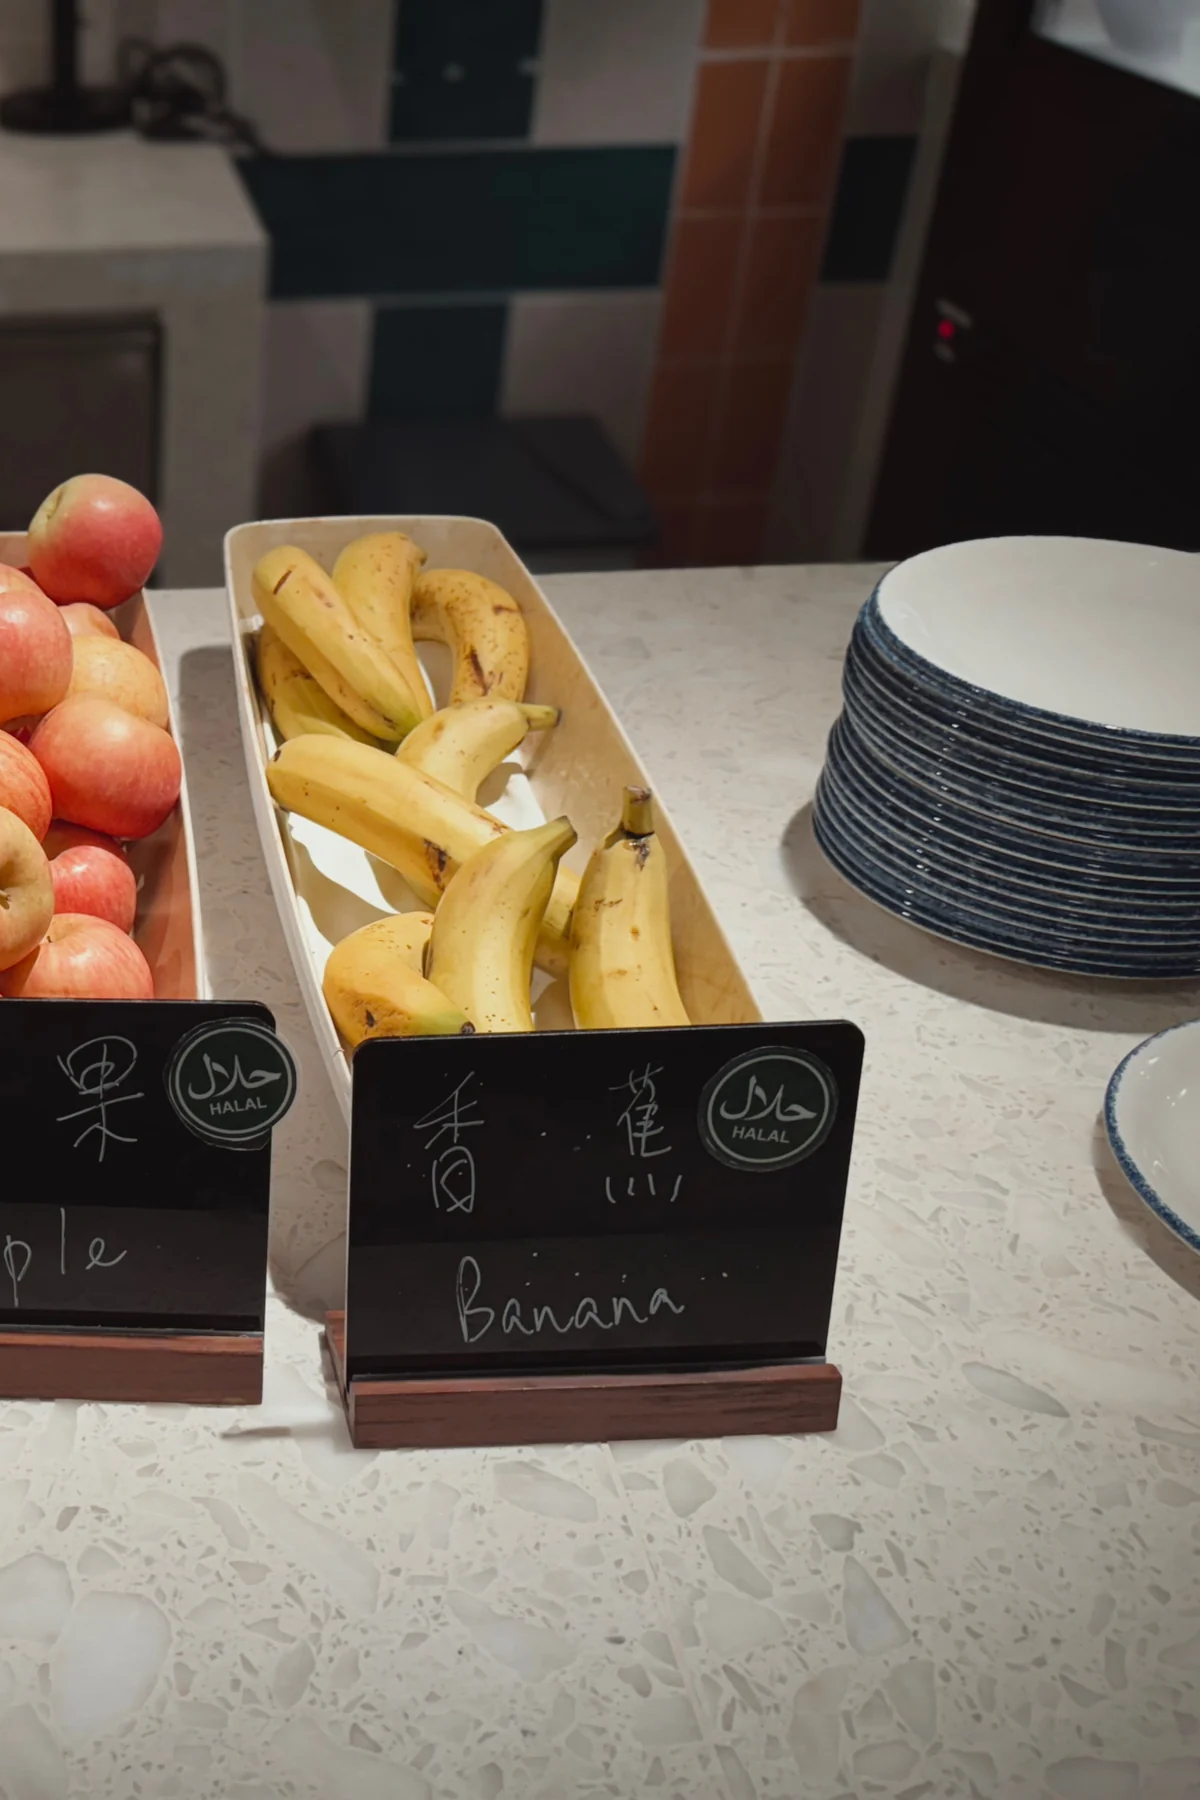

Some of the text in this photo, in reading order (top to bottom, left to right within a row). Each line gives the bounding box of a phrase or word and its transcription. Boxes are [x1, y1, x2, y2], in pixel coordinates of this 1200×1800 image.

[187, 1052, 282, 1099] حلال
[719, 1075, 818, 1122] حلال
[209, 1097, 267, 1116] HALAL
[412, 1062, 683, 1213] 香蕉
[731, 1125, 790, 1144] HALAL
[455, 1255, 685, 1343] Banana
